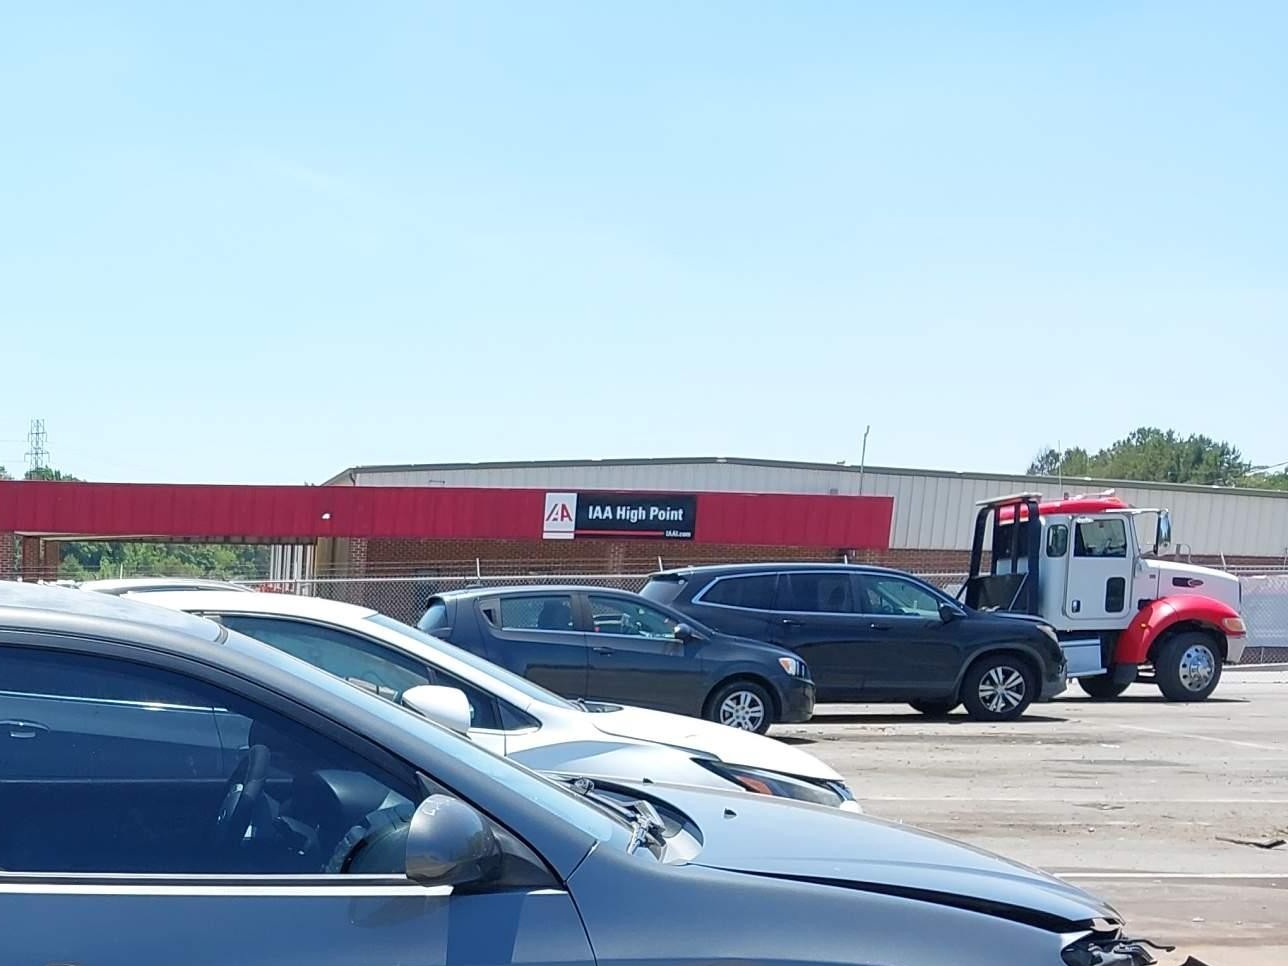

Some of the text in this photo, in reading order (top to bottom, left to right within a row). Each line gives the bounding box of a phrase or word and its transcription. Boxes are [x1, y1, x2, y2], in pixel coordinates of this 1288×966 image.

[588, 506, 684, 522] IAA High Point
